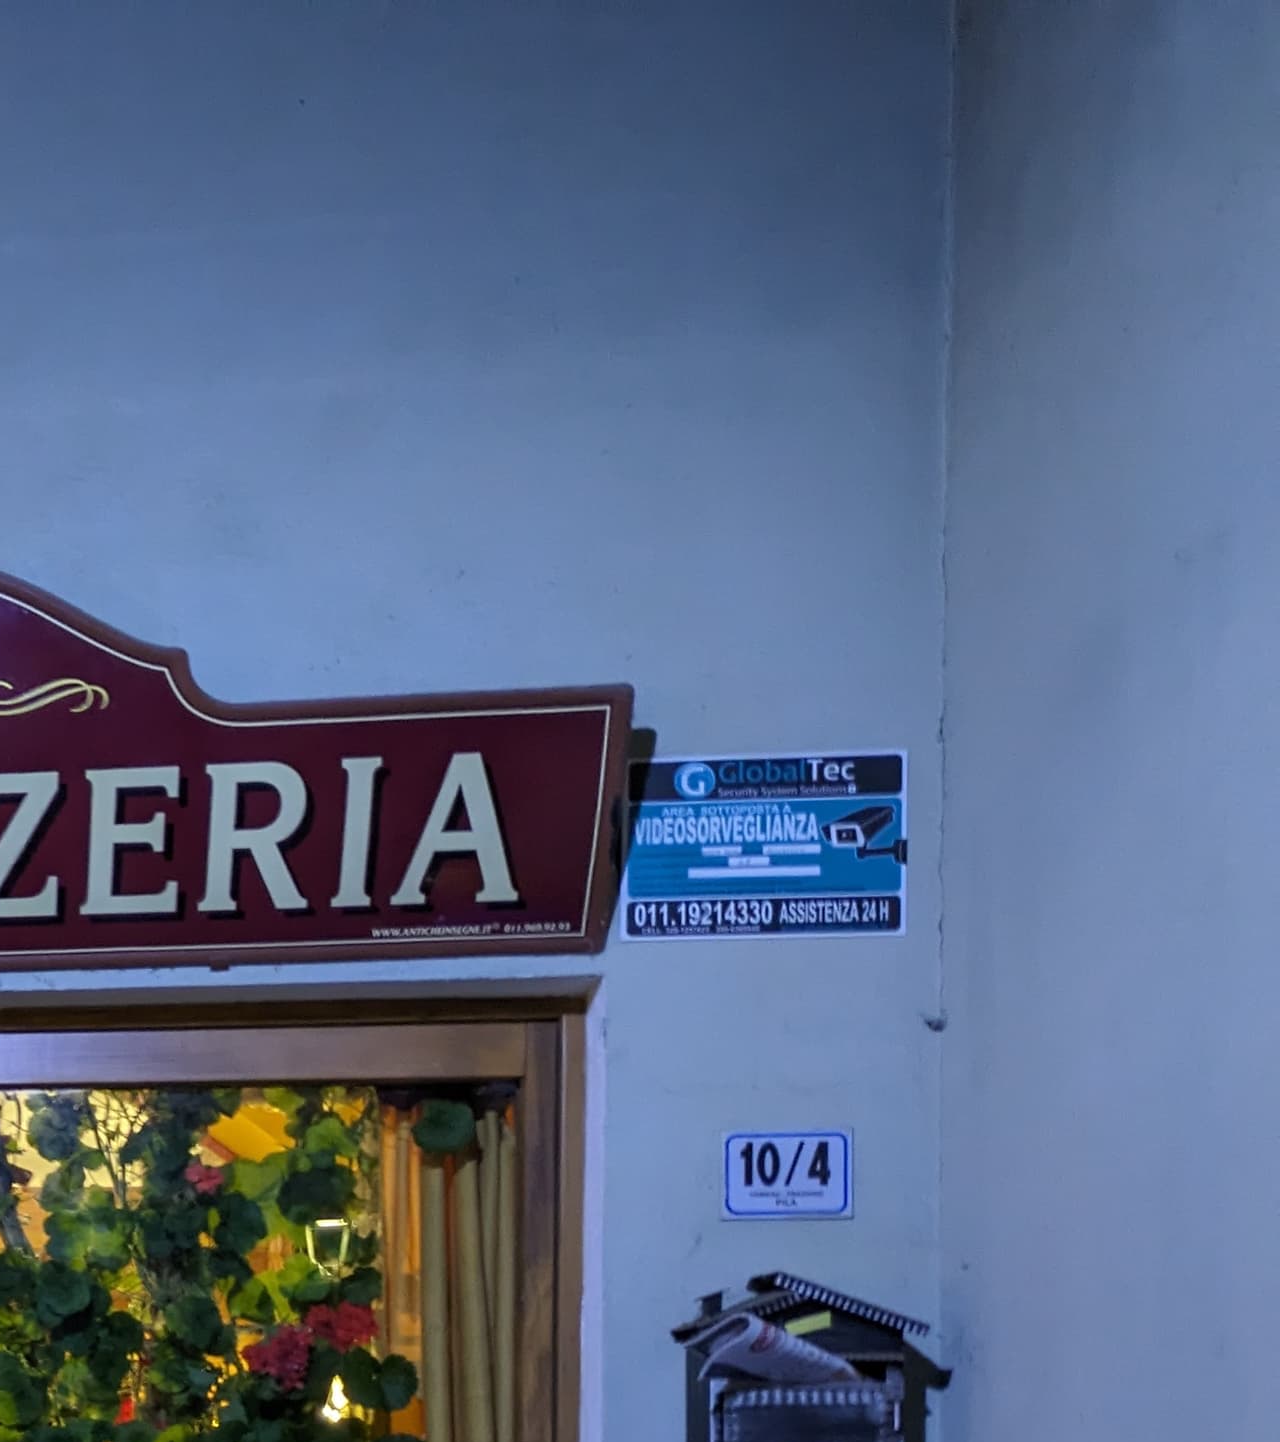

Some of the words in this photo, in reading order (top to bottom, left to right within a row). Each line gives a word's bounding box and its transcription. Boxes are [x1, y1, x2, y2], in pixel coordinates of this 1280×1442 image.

[718, 758, 856, 785] GlobalTec
[661, 806, 695, 817] AREA
[700, 803, 776, 816] SOTTOPOSTA
[634, 813, 819, 846] VIDEOSORVEGLIANZA
[634, 903, 773, 927] 011.19214330
[779, 901, 859, 925] ASSISTENZA
[862, 901, 878, 922] 24
[880, 900, 890, 921] H
[739, 1140, 831, 1187] 10/4
